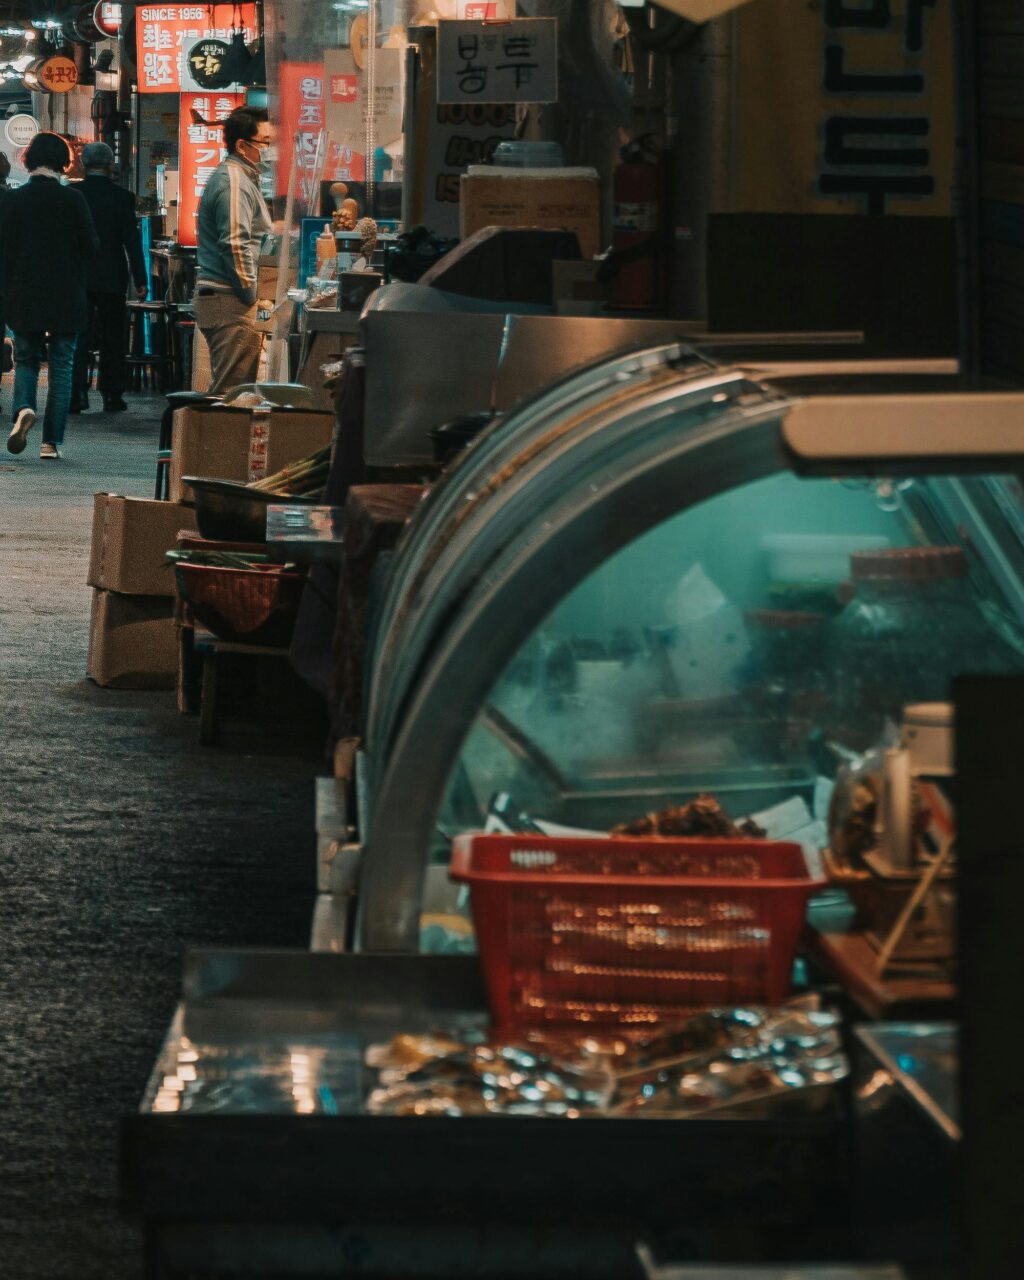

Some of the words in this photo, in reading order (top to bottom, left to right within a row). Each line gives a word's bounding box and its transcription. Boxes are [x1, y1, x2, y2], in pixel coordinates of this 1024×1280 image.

[141, 8, 176, 21] SINCE
[178, 7, 206, 20] 1956
[143, 52, 173, 87] 원조
[456, 33, 539, 95] 봉투
